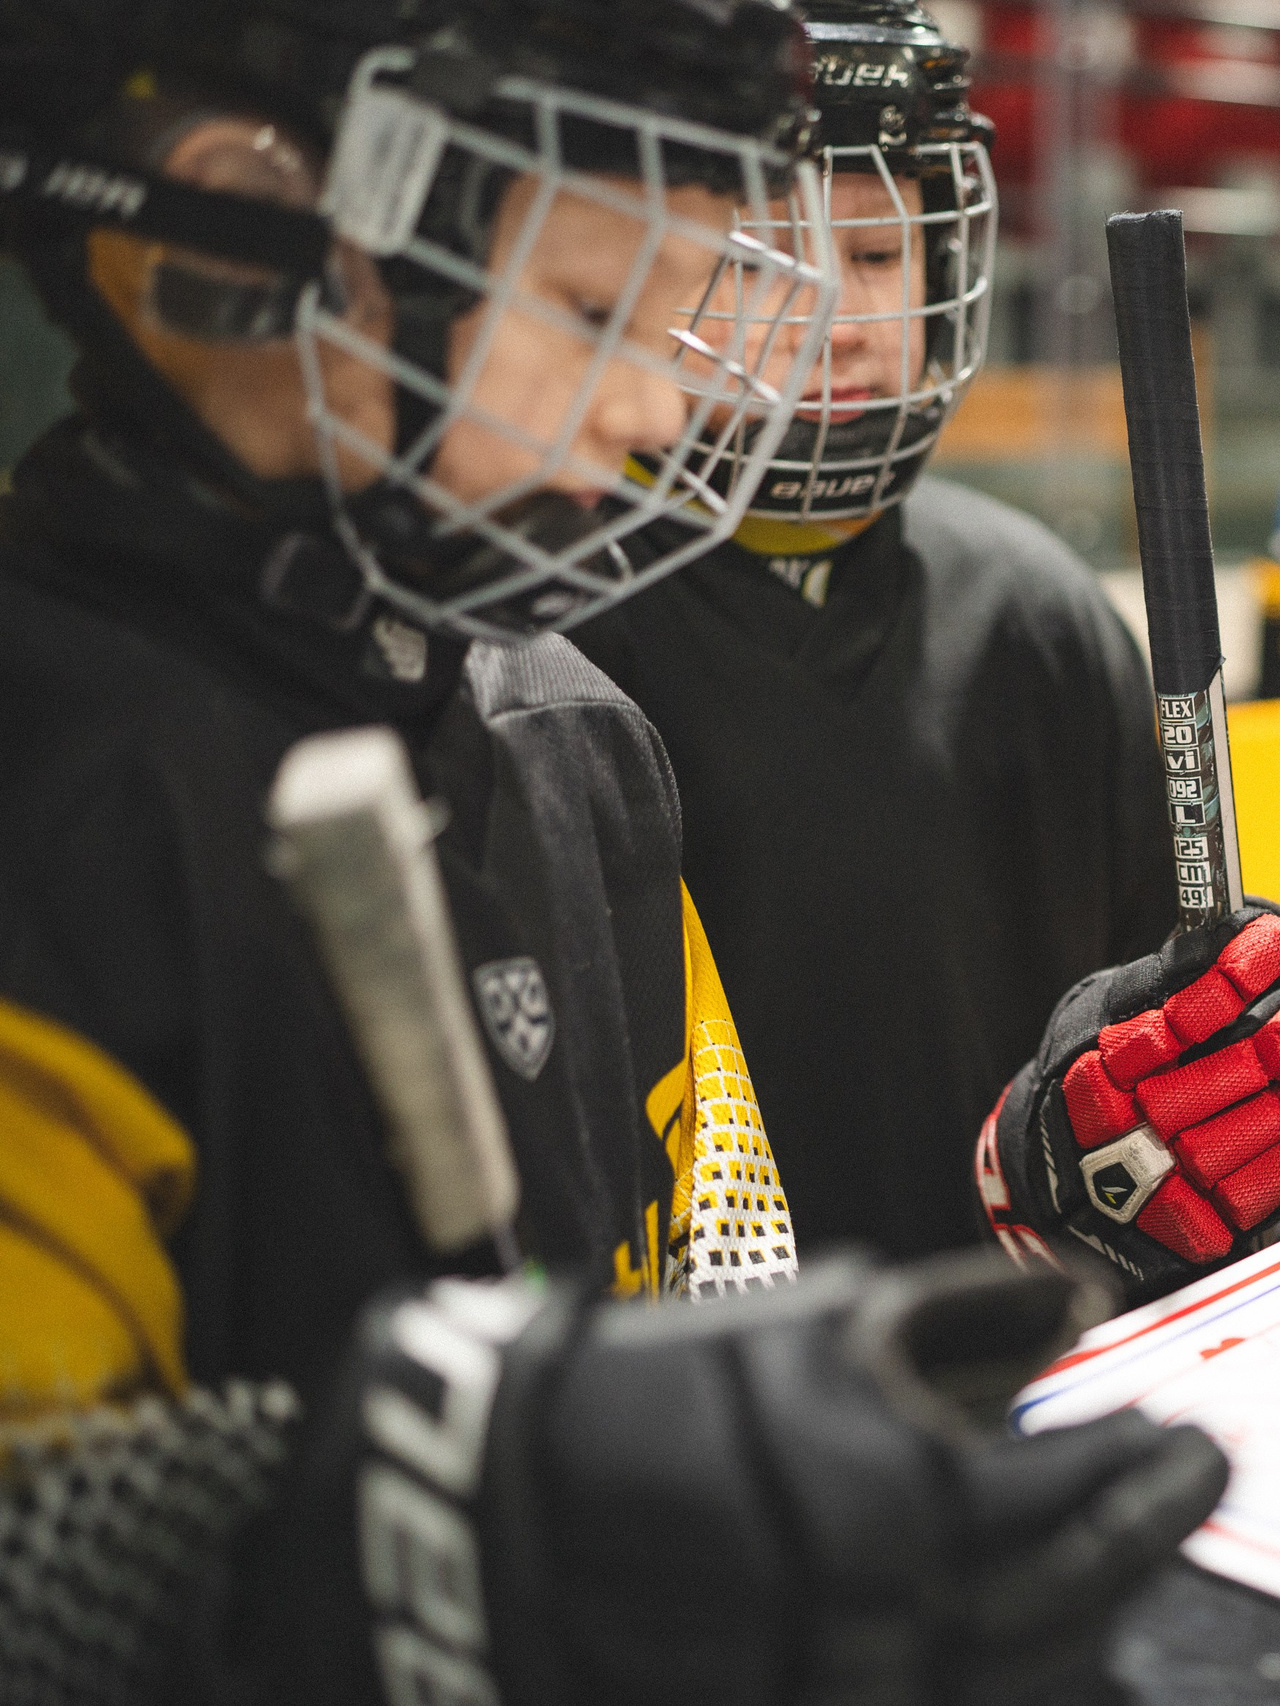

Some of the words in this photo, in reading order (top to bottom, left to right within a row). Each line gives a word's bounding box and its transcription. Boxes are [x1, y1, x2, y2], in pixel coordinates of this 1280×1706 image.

[1161, 700, 1192, 718] FLEX
[1163, 726, 1193, 744] 20
[1175, 806, 1196, 823] L
[1176, 839, 1204, 856] 125
